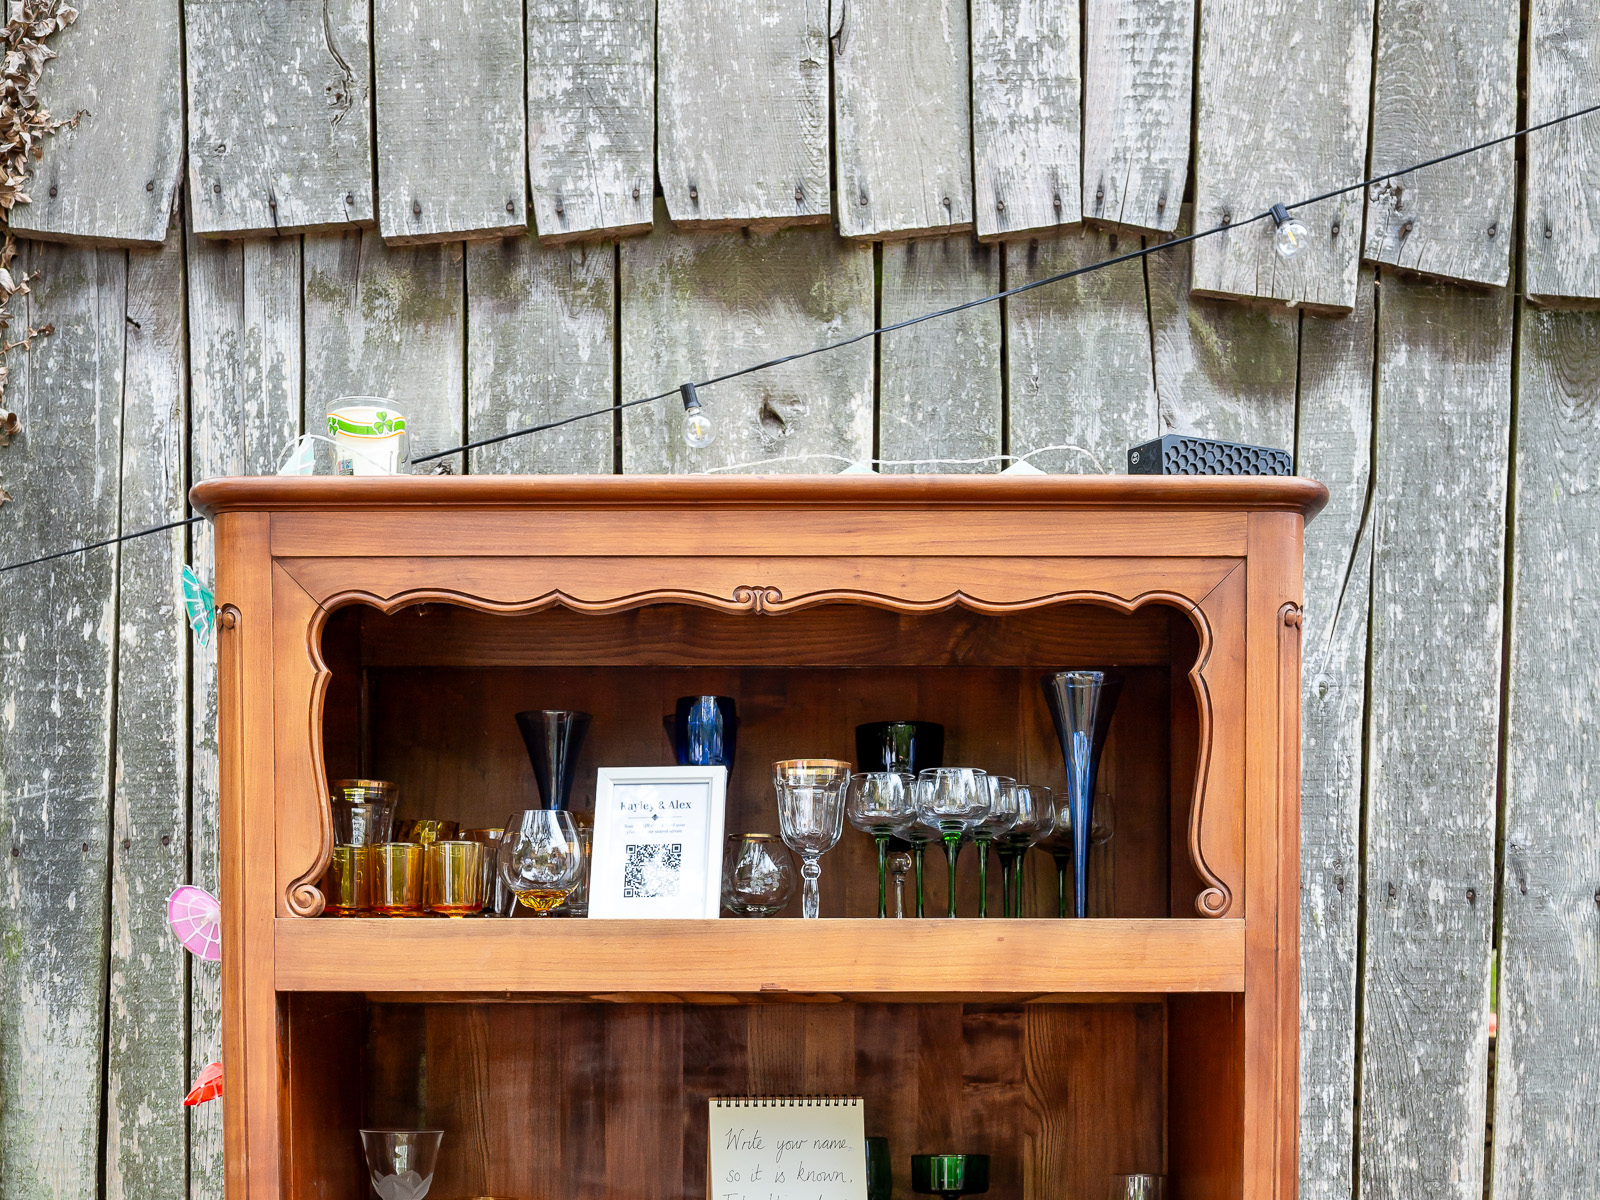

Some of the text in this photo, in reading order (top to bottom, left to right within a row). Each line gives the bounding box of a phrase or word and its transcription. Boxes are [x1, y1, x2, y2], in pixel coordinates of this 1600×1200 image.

[658, 801, 666, 810] &
[668, 800, 692, 810] Alex
[725, 1128, 765, 1150] Write
[776, 1139, 807, 1163] your
[726, 1169, 741, 1183] so
[750, 1164, 762, 1182] it
[775, 1166, 786, 1183] is
